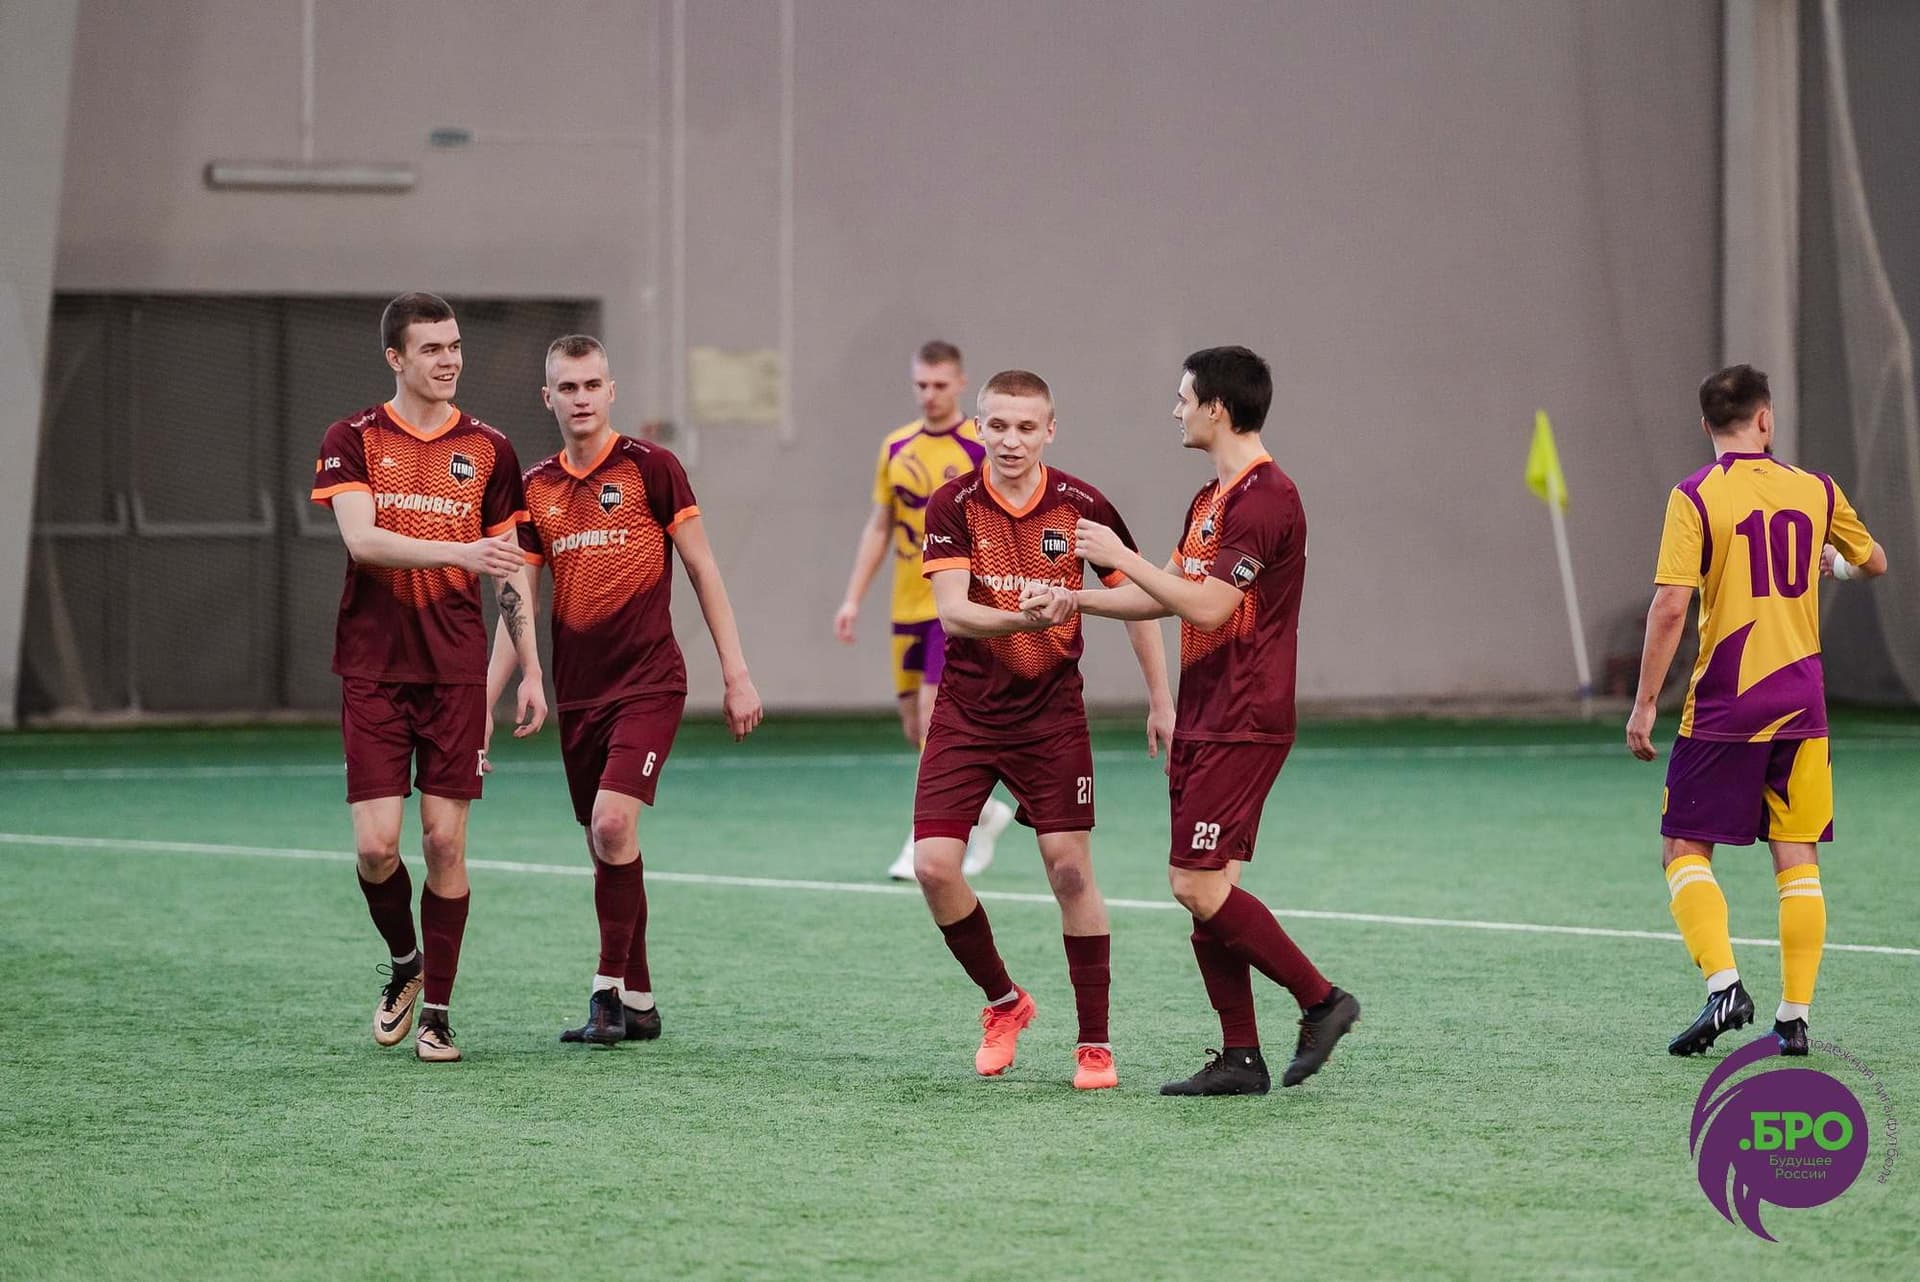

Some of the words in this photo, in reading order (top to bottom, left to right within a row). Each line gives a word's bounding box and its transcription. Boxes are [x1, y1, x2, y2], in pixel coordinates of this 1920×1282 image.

[452, 462, 474, 478] ТЕМП
[374, 492, 471, 518] ПРОДИНВЕСТ
[1043, 539, 1066, 552] ТЕМП
[1735, 509, 1814, 599] 10
[642, 751, 656, 777] 6
[1191, 822, 1220, 850] 23
